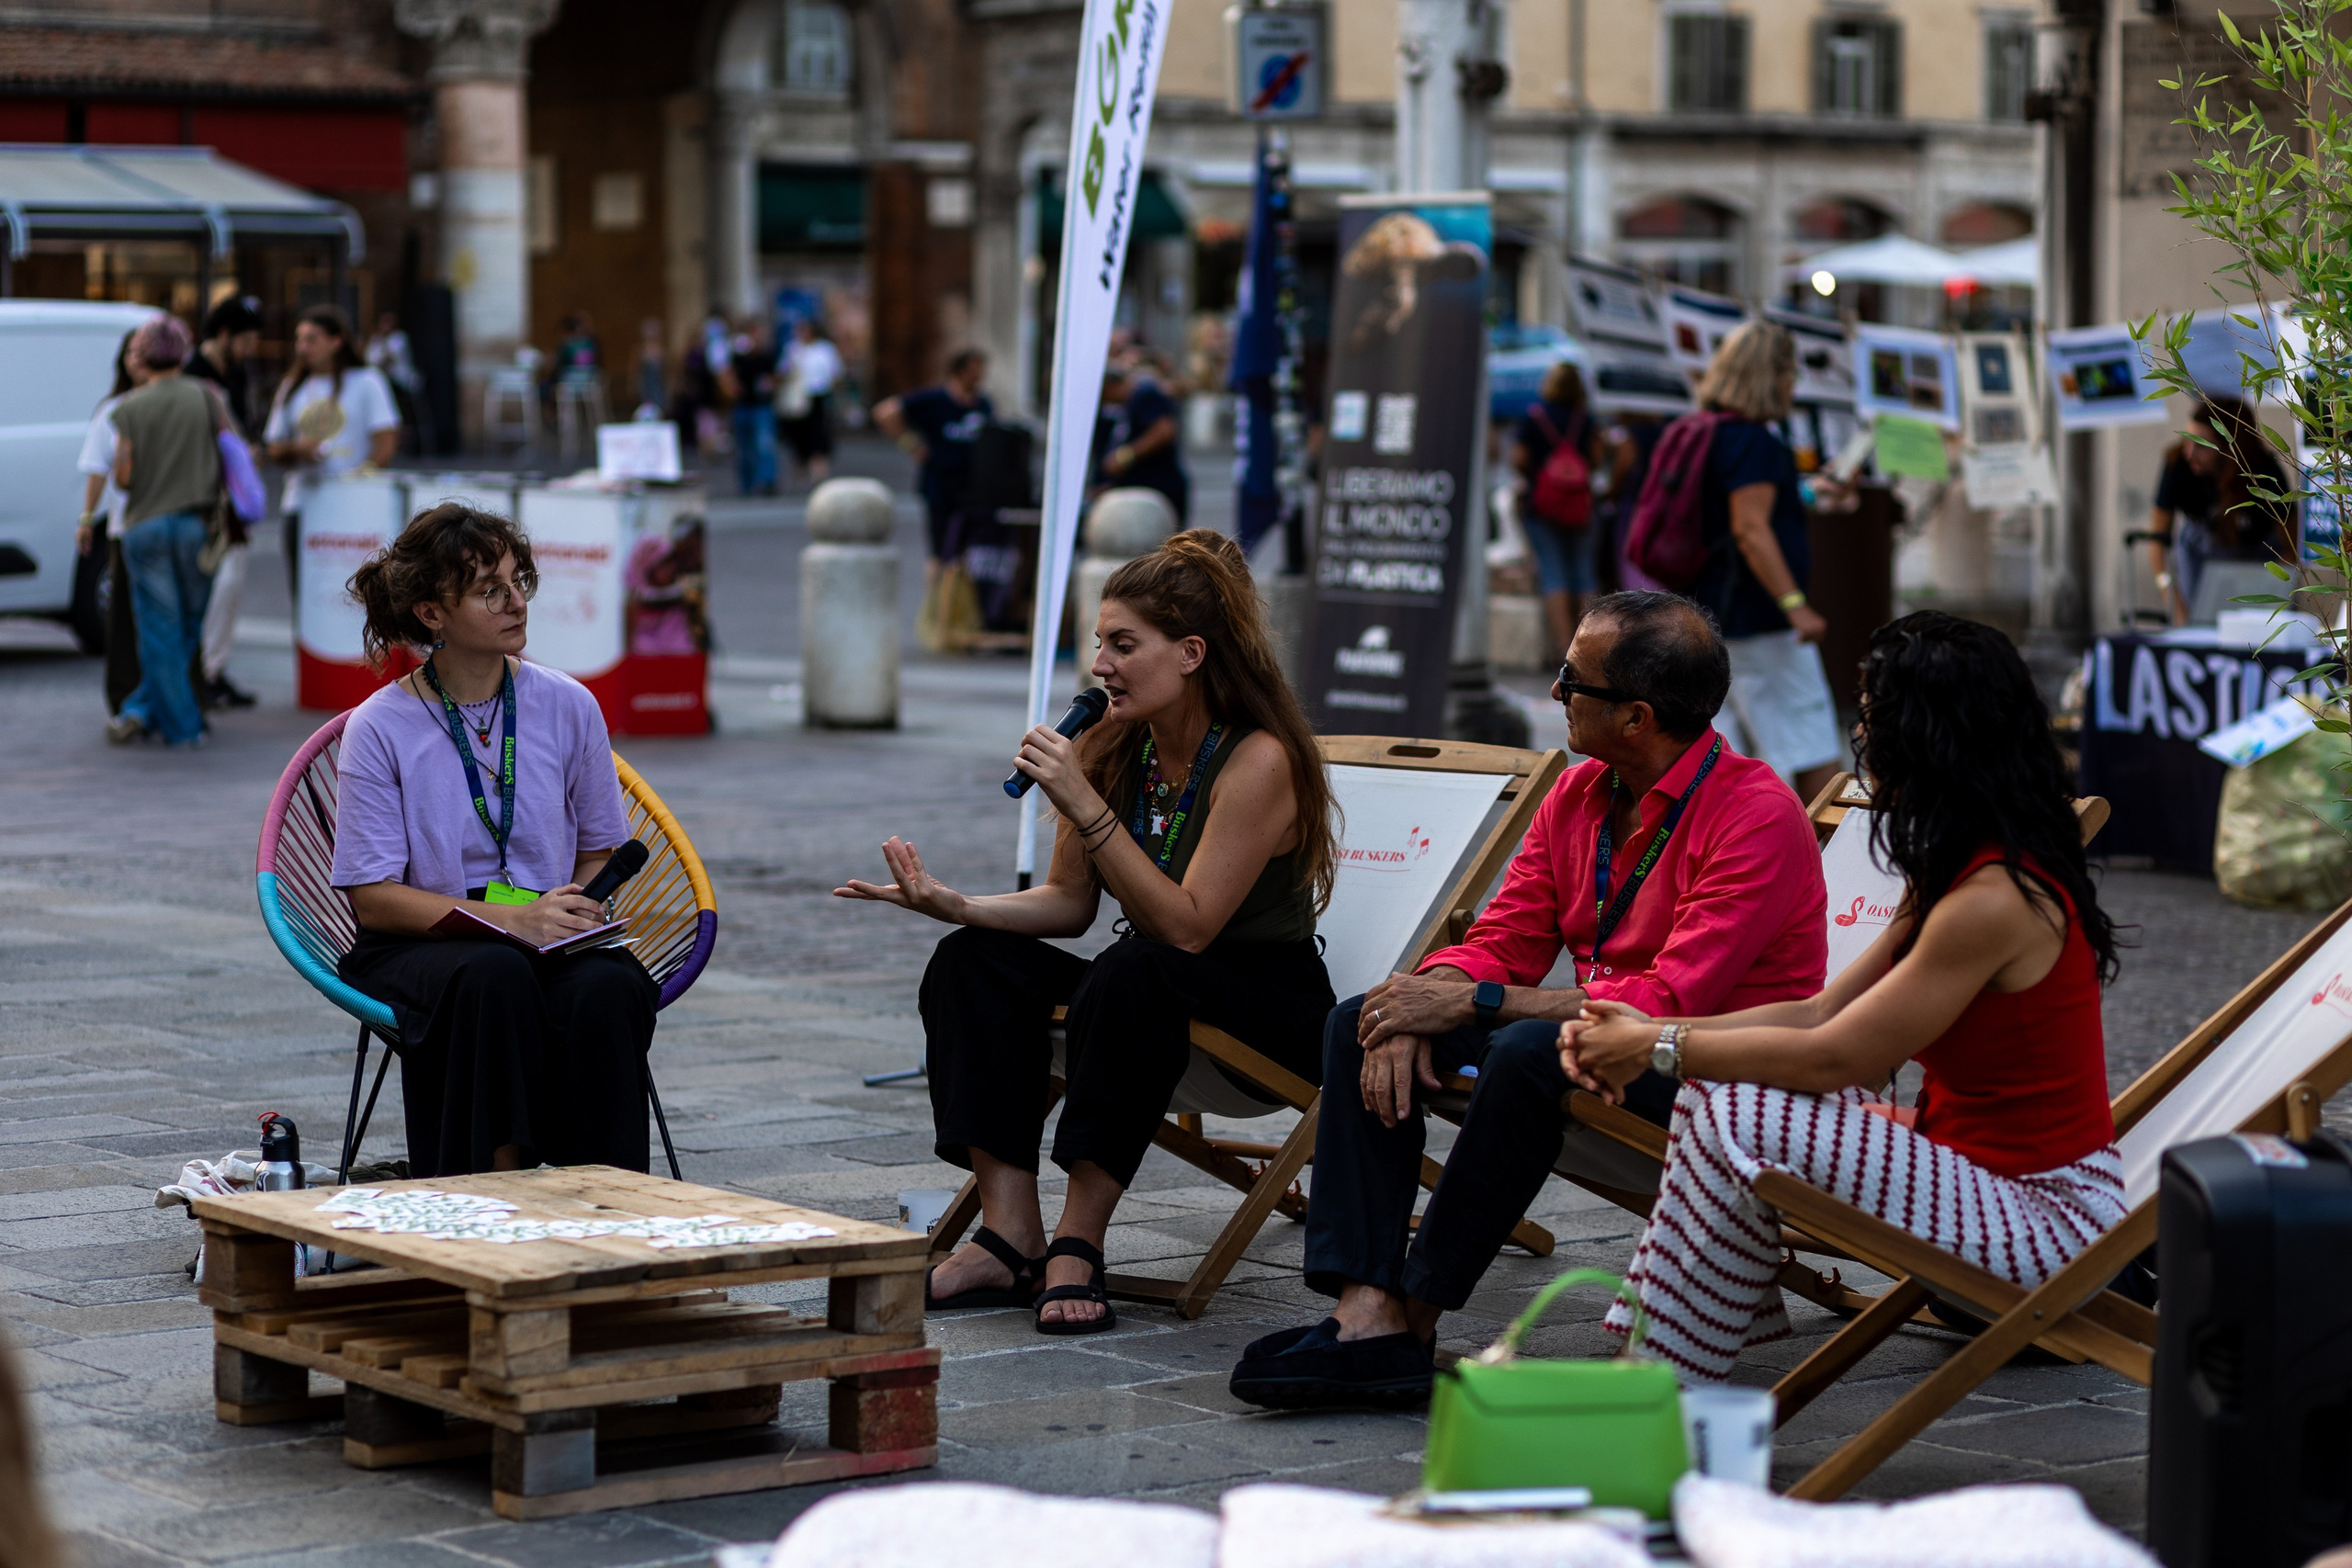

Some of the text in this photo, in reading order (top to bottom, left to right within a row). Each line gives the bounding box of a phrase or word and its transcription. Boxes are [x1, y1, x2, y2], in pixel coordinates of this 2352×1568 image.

[447, 711, 501, 841] BUSKERS BuskerS
[504, 736, 515, 784] BuskerS
[1160, 732, 1220, 862] BUSKERS BuskerS
[1350, 849, 1408, 863] BUSKERS
[1634, 827, 1669, 879] BuskerS
[1601, 877, 1641, 935] BUSKERS
[1867, 904, 1896, 919] OASI
